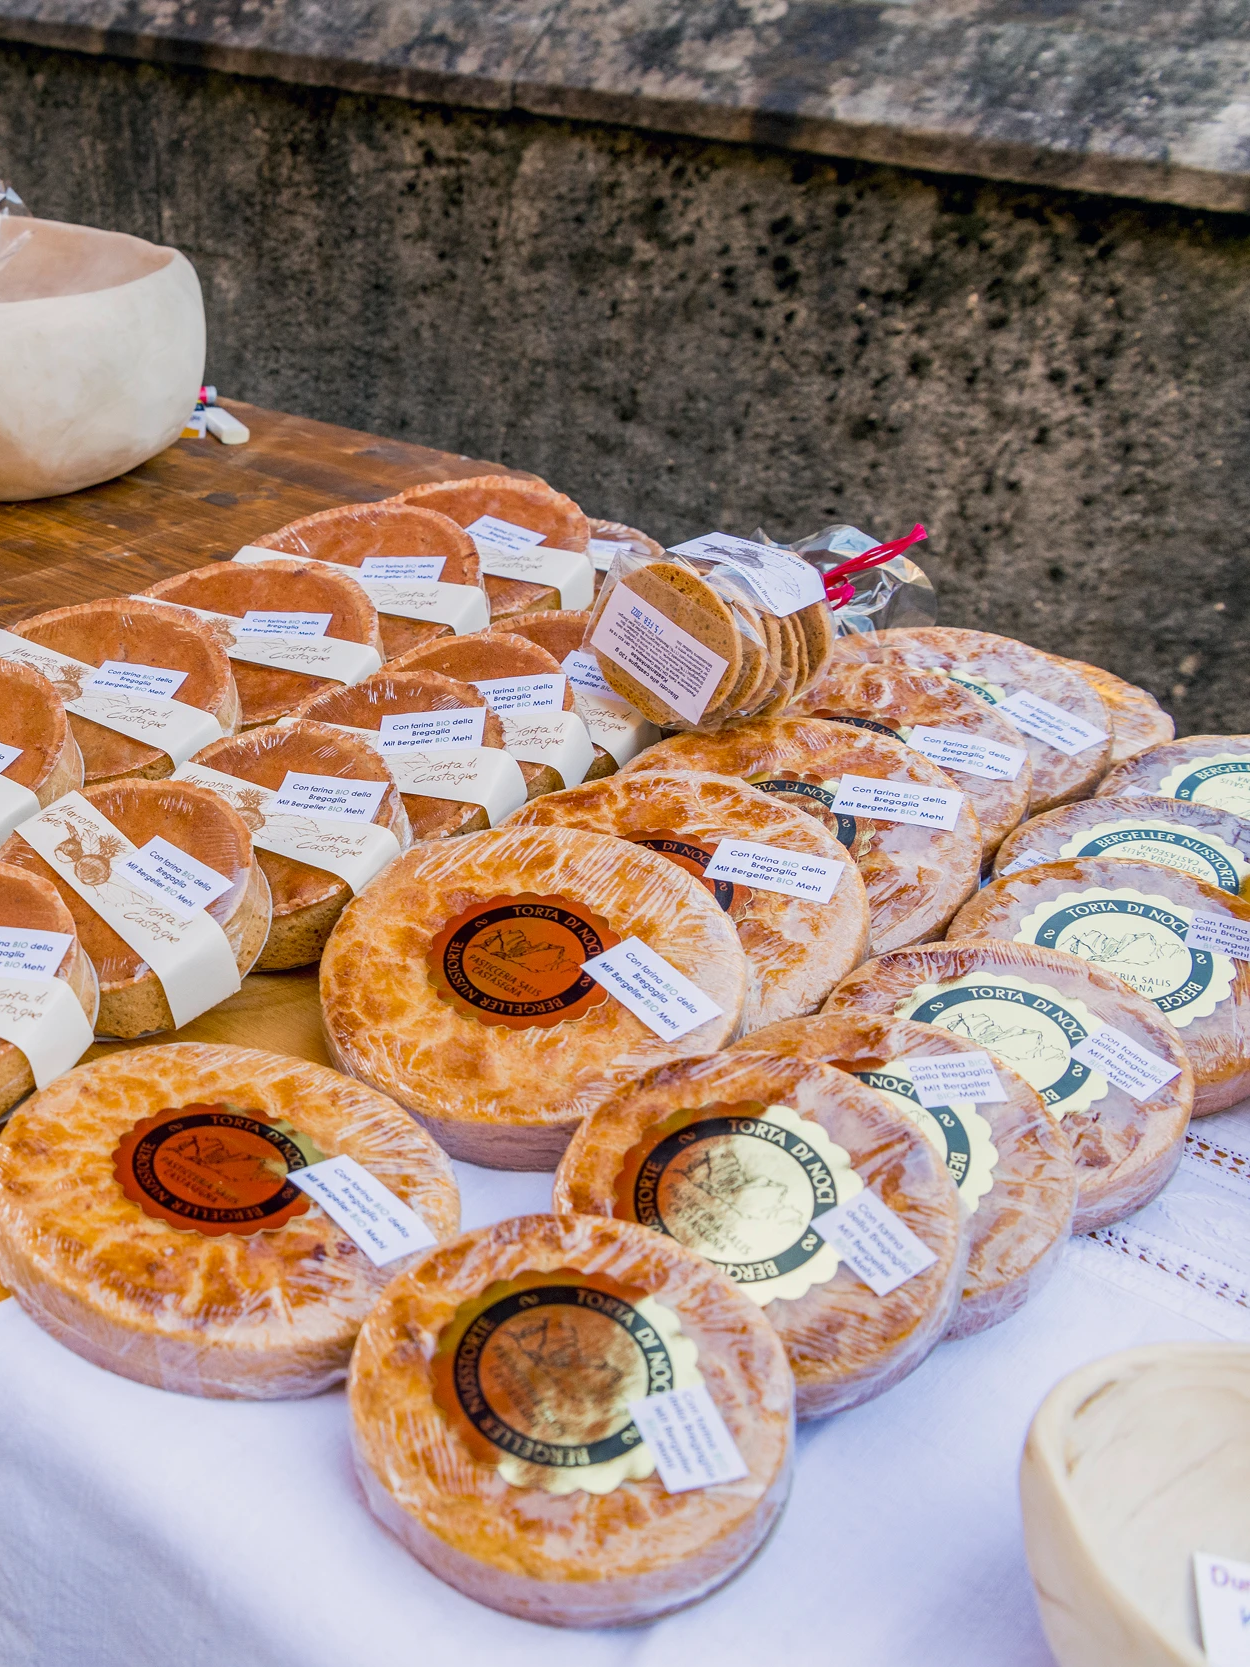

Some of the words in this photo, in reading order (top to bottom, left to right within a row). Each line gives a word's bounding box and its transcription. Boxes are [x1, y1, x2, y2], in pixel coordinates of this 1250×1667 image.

[630, 605, 643, 620] 2022
[391, 723, 410, 731] Con
[410, 721, 434, 729] farina
[435, 719, 451, 727] BIO
[451, 717, 473, 726] della
[411, 727, 451, 737] Bregaglia
[396, 738, 433, 746] Bergeller
[450, 734, 473, 742] Mehl
[1194, 762, 1250, 780] BERGELL
[291, 782, 310, 791] Con
[309, 784, 334, 795] farina
[334, 788, 350, 796] BIO
[350, 790, 372, 798] della
[307, 792, 347, 804] Bregaglia
[851, 785, 872, 794] Con
[872, 788, 901, 798] farina
[902, 792, 920, 800] BIO
[921, 795, 947, 805] della
[276, 798, 290, 806] Mit
[290, 800, 327, 810] Bergeller
[326, 804, 343, 813] BIO
[343, 806, 366, 815] Mehl
[838, 799, 854, 807] Mit
[855, 801, 898, 813] Bergeller
[899, 808, 918, 816] BIO
[918, 811, 944, 821] Mehl
[873, 795, 919, 808] Bregaglia
[729, 849, 750, 858] Con
[751, 852, 780, 865] farina
[780, 859, 800, 869] BIO
[800, 864, 827, 875] della
[750, 860, 797, 877] Bregaglia
[1094, 830, 1176, 849] BERGELLER
[1180, 838, 1237, 888] NUSSTORTE
[713, 864, 730, 872] Mit
[730, 866, 774, 881] Bergeller
[775, 876, 794, 886] BIO
[794, 881, 822, 892] Mehl
[1065, 901, 1120, 919] TORTA
[1126, 902, 1146, 914] DI
[1148, 908, 1190, 934] NOCI
[512, 905, 560, 922] TORTA
[564, 915, 579, 930] DI
[577, 926, 602, 957] NOCI
[446, 939, 480, 1000] NUSSTORTE
[467, 953, 519, 988] PASTICCERIA
[518, 979, 543, 998] SALIS
[470, 965, 522, 999] CASTASEGNA
[1141, 976, 1172, 988] SALIS
[481, 993, 565, 1017] BERGELLER
[967, 987, 1026, 1003] TORTA
[1031, 997, 1052, 1012] DI
[1051, 1010, 1087, 1042] NOCI
[908, 1064, 932, 1072] Con
[933, 1061, 966, 1070] farina
[911, 1072, 939, 1081] della
[940, 1065, 994, 1079] Bregaglia
[868, 1074, 916, 1097] NOCI
[923, 1084, 941, 1092] Mit
[942, 1080, 990, 1090] Bergeller
[209, 1114, 261, 1134] TORTA
[265, 1130, 285, 1144] DI
[727, 1117, 787, 1147] TORTA
[789, 1142, 807, 1163] DI
[805, 1161, 836, 1204] NOCI
[577, 1289, 635, 1326] TORTA
[634, 1330, 651, 1350] DI
[648, 1352, 673, 1394] NOC
